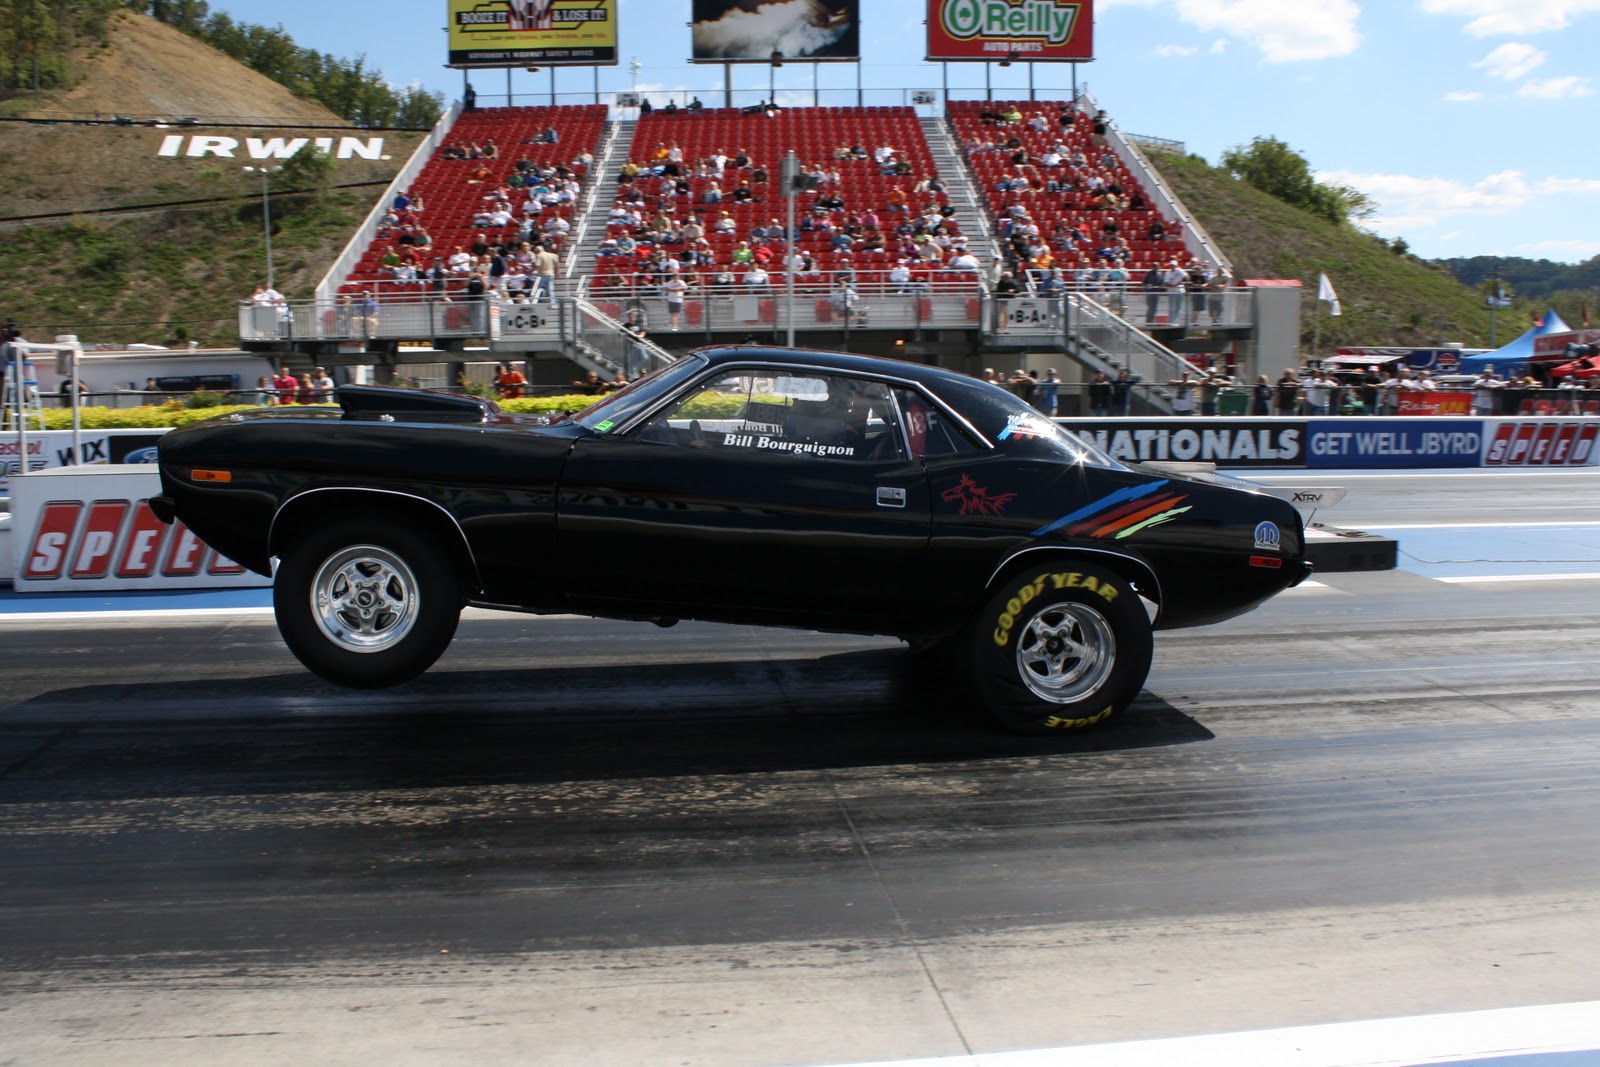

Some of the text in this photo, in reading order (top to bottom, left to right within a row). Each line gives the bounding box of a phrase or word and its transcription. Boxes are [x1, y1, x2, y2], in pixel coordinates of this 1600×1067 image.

[461, 12, 495, 24] BOOZE
[496, 12, 507, 22] IT
[552, 10, 561, 21] &
[562, 10, 588, 21] LOSE
[982, 42, 1044, 52] AUTO PARTS
[57, 438, 106, 467] WIX
[723, 433, 855, 456] Bill Bourguignon
[1077, 429, 1300, 461] NATIONALS
[1311, 432, 1480, 455] GET WELL JBYRD
[1488, 437, 1593, 461] SPEED
